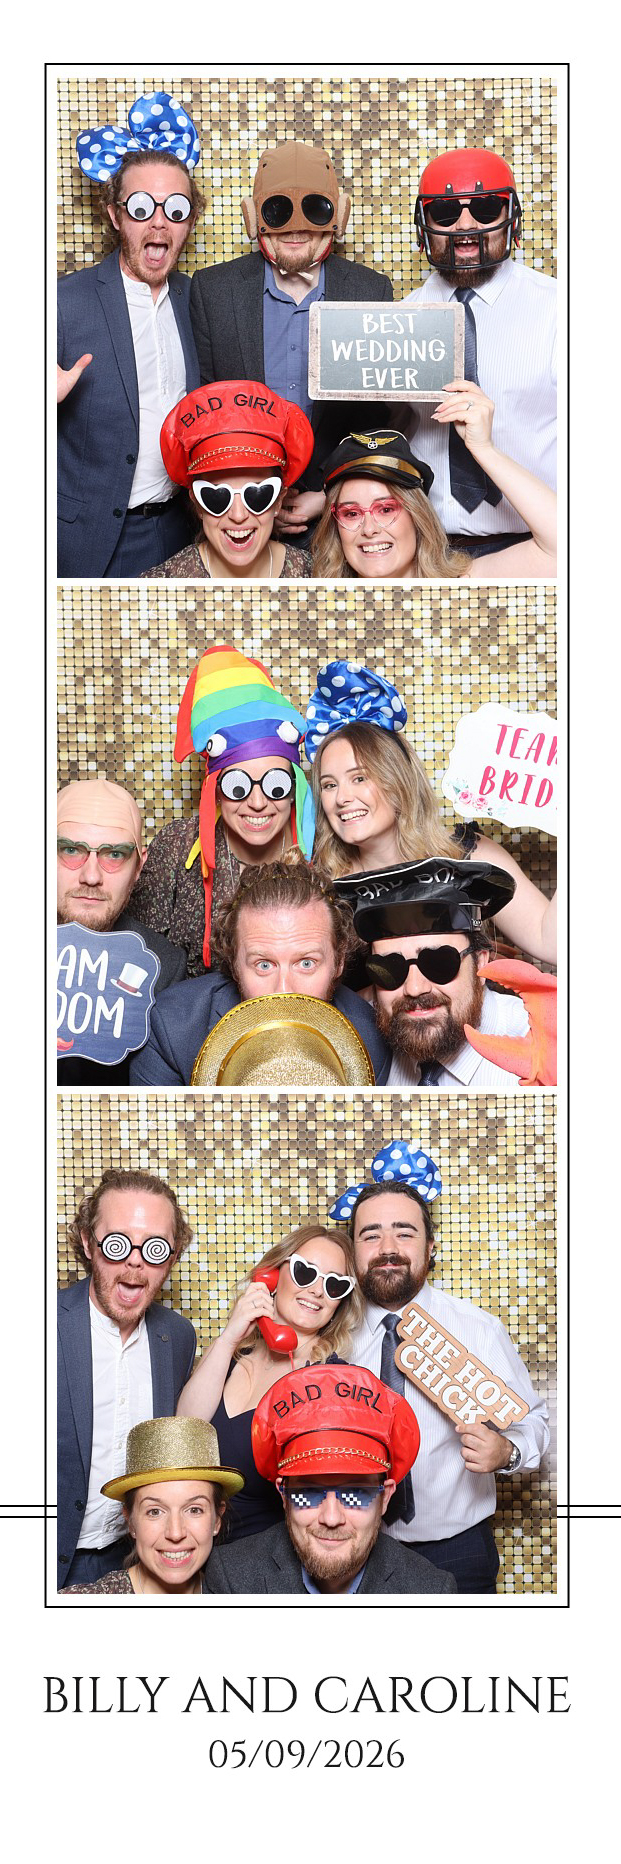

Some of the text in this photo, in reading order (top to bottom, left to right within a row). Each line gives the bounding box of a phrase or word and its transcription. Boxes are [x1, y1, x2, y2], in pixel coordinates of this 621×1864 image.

[362, 313, 417, 334] BEST
[331, 339, 446, 362] WEDDING
[361, 367, 419, 389] EVER
[180, 393, 277, 428] BAD GIRL
[478, 765, 557, 810] BRID
[402, 1309, 523, 1423] THE HOT
[273, 1382, 382, 1418] BAD GIRL
[400, 1344, 487, 1425] CHICK
